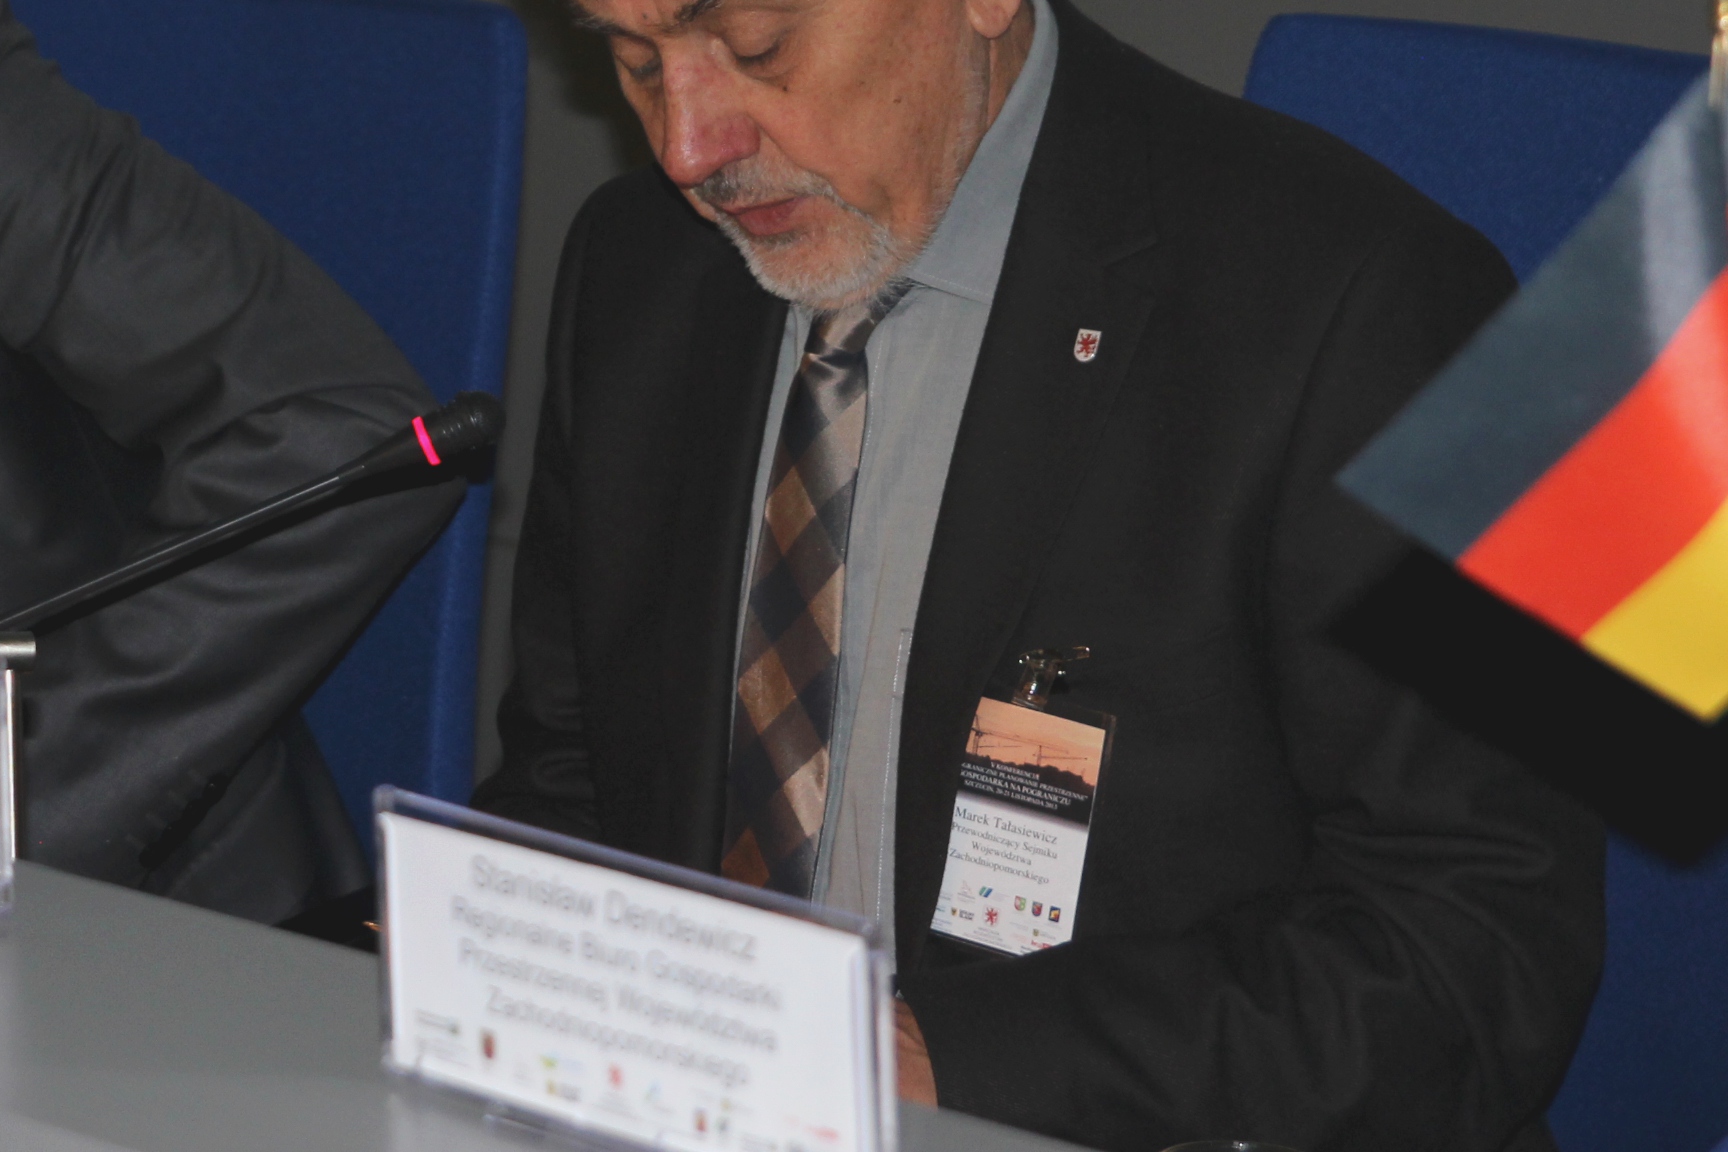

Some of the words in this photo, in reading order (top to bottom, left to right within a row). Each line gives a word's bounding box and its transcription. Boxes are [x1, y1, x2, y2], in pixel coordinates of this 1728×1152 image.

[952, 822, 1021, 848] Przewodniczący
[1023, 841, 1058, 860] Sejmiku
[955, 806, 990, 826] Marek
[993, 816, 1058, 845] Tałasiewicz
[949, 848, 1050, 885] Zachodniopomorskiego
[971, 840, 1032, 866] Województwa
